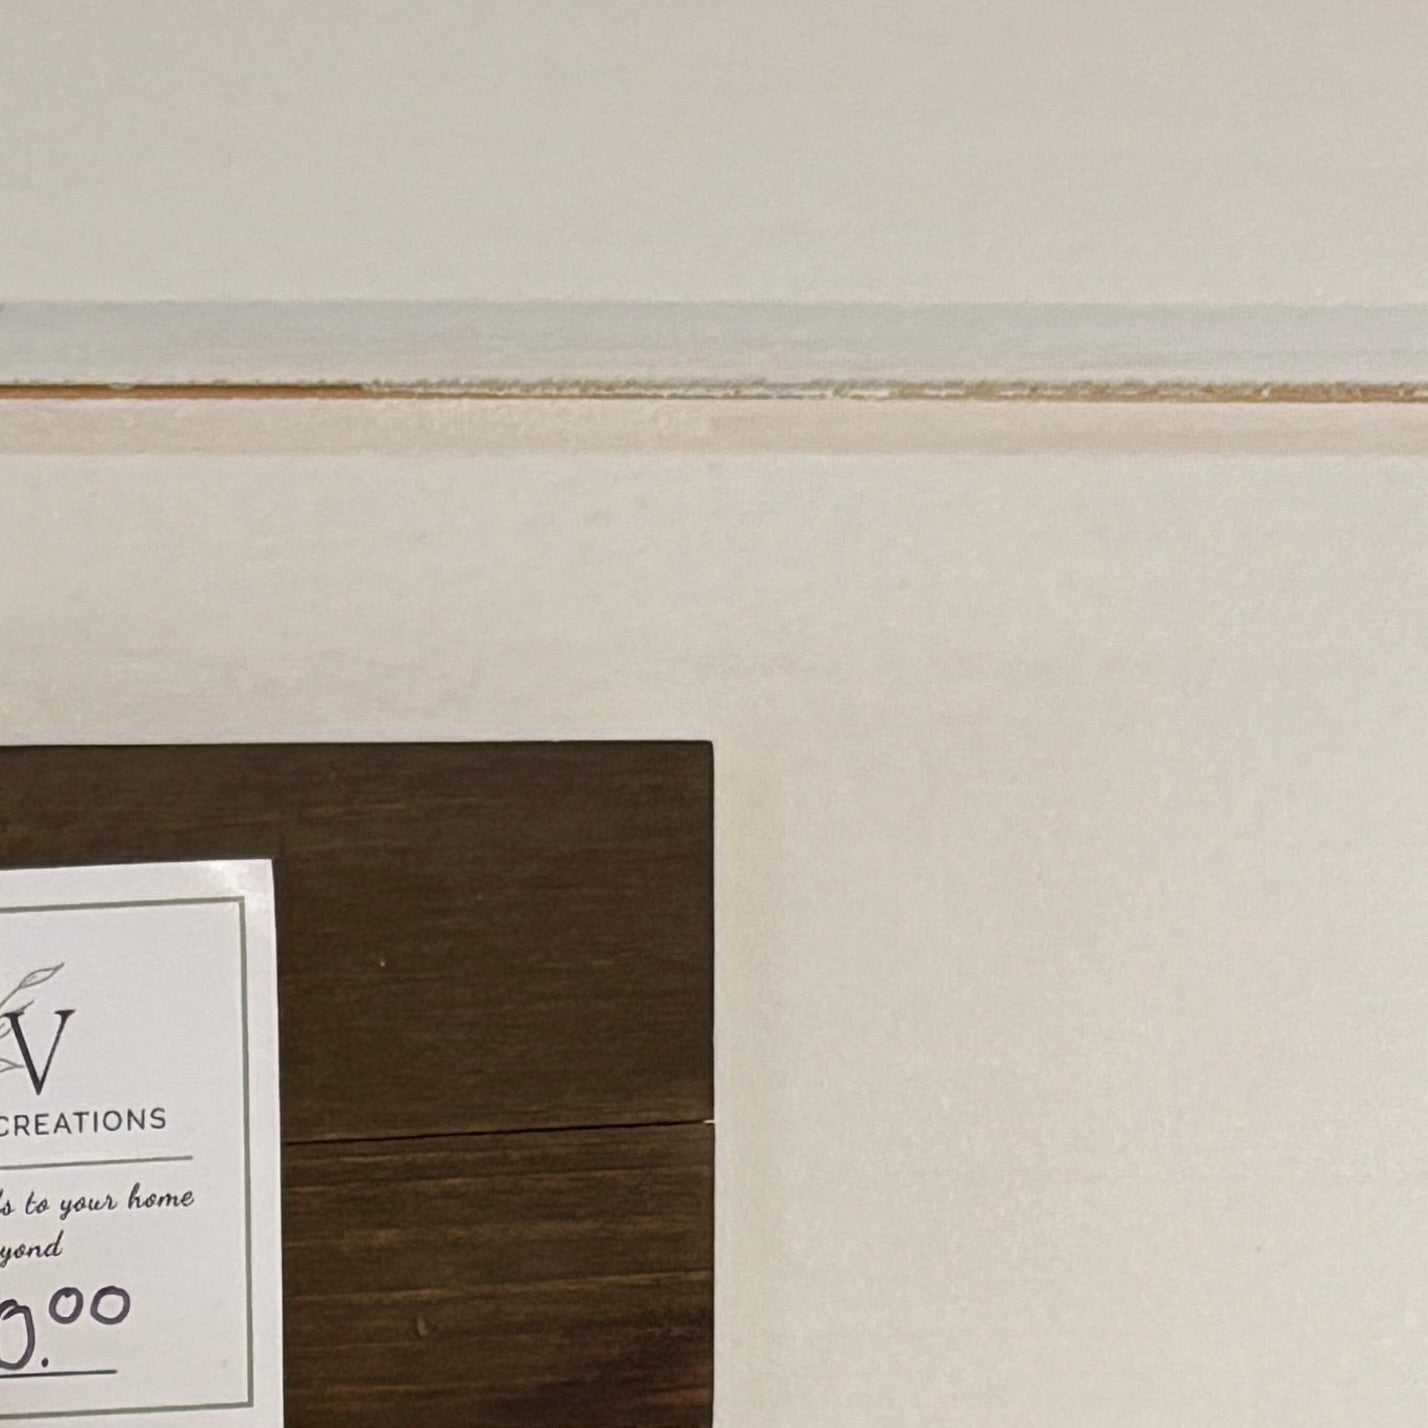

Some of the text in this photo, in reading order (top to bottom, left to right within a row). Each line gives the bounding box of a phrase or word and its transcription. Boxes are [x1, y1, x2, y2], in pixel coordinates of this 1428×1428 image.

[24, 1187, 51, 1215] to
[59, 1191, 118, 1223] your
[127, 1183, 195, 1210] home
